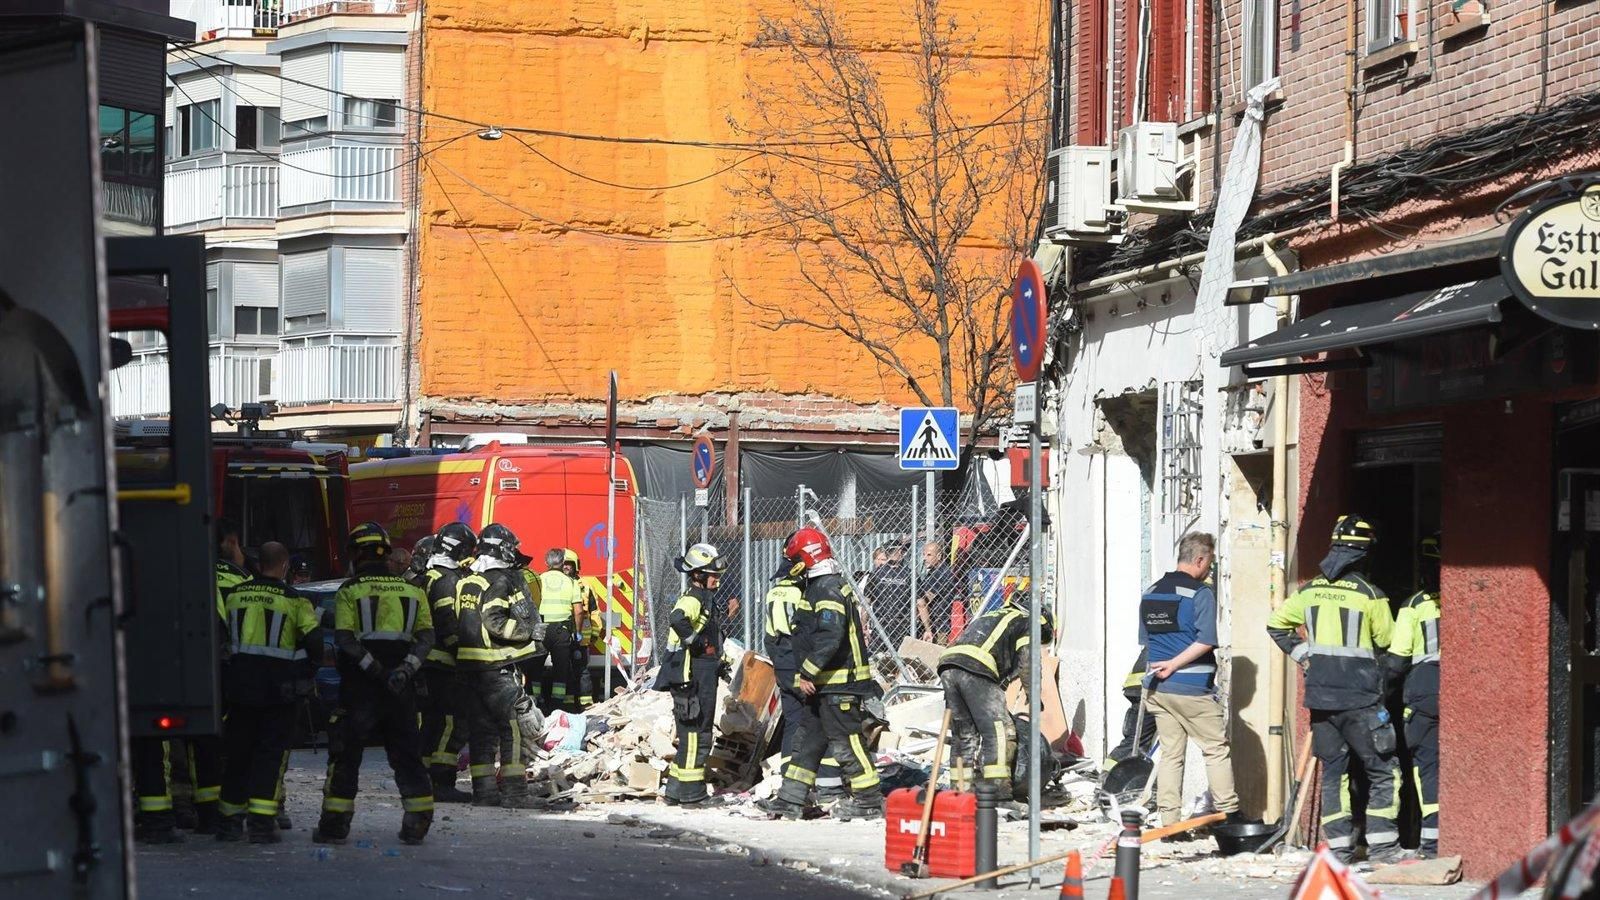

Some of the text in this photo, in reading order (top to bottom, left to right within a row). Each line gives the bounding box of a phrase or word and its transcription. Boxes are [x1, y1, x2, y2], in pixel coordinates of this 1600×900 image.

[1541, 257, 1599, 290] Gal
[236, 584, 285, 595] BOMBEROS
[370, 584, 405, 592] MADRID
[1312, 579, 1358, 590] BOMEROS
[240, 595, 274, 605] MADRID
[1314, 593, 1346, 601] MADRID
[900, 819, 946, 837] HITI
